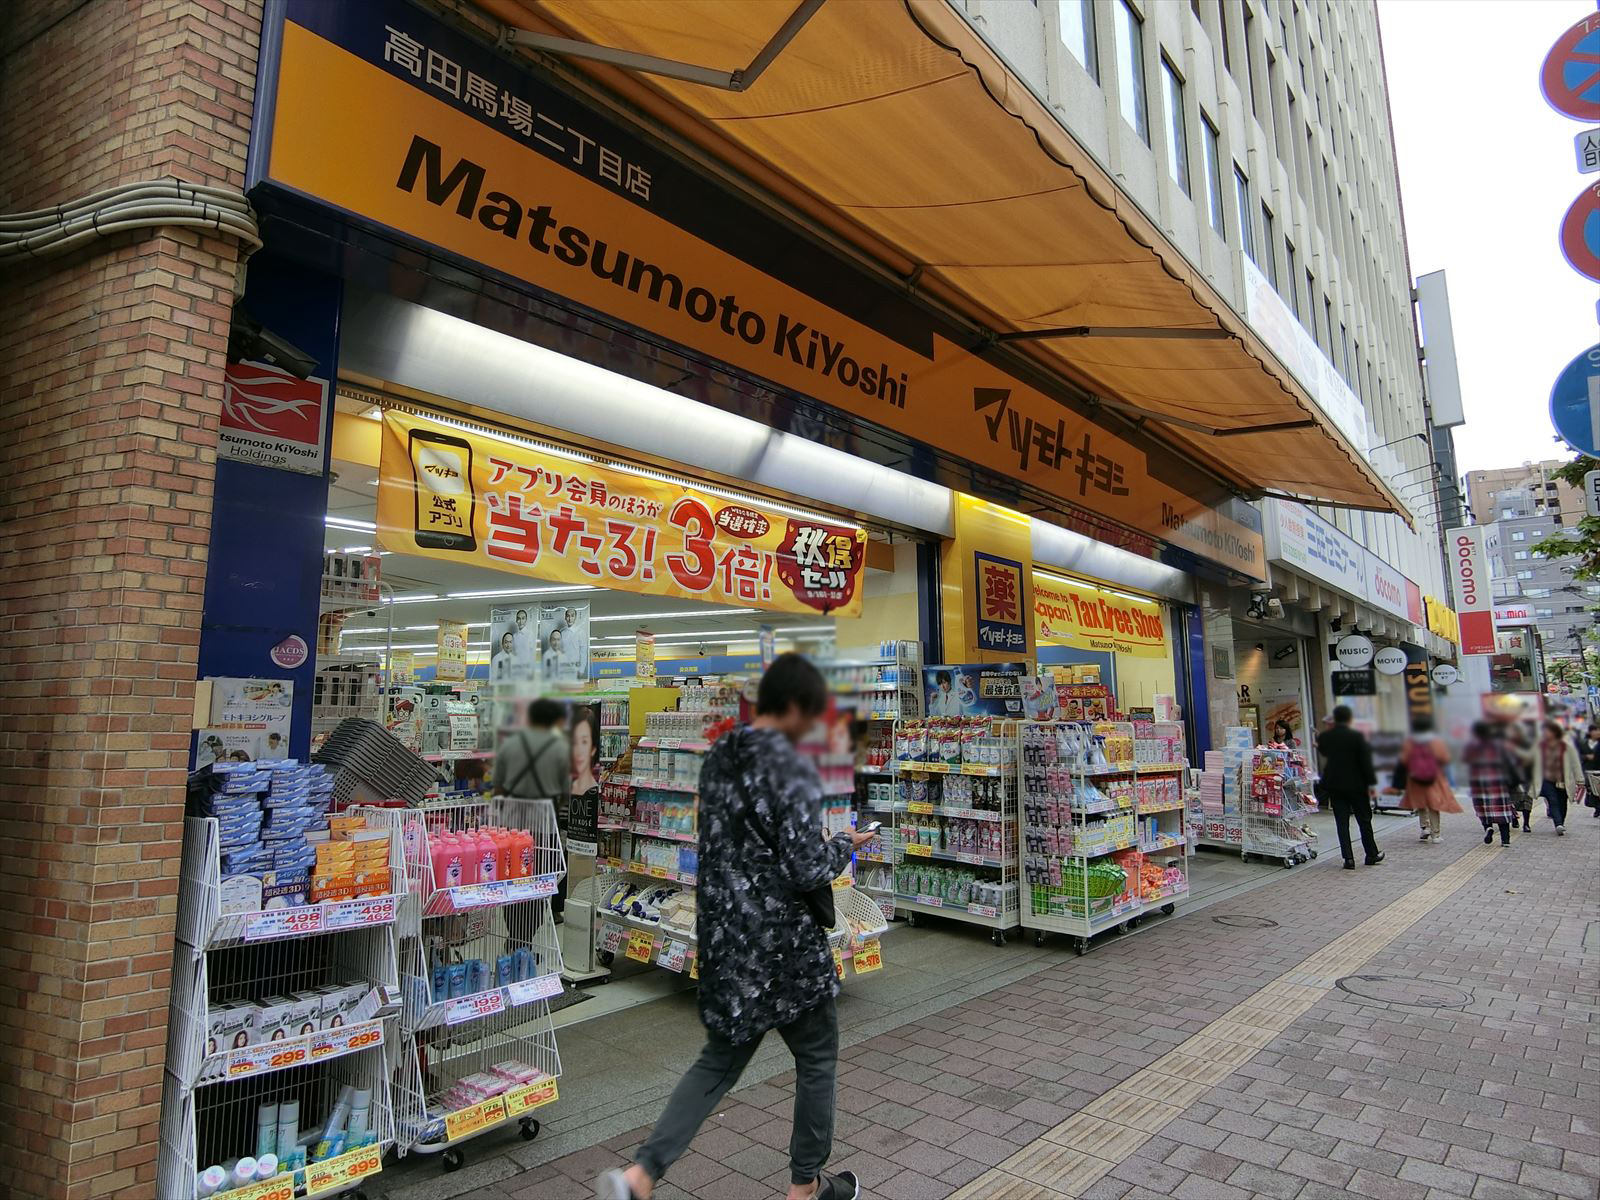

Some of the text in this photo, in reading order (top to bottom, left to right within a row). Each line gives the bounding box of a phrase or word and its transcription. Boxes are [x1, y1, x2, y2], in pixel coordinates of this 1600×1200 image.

[384, 25, 652, 201] 高田馬場二丁目店
[396, 134, 909, 410] Matsumoto KiYoshi
[274, 442, 319, 459] KiYoshi
[974, 387, 1129, 497] マツモトキヨシ
[230, 445, 287, 464] Holdings
[488, 457, 662, 519] アプリ会員のほうが
[432, 495, 457, 512] 公式
[429, 510, 464, 528] アプリ
[717, 510, 768, 535] 当選確率
[791, 526, 853, 569] 秋得
[801, 567, 848, 589] セール
[1456, 535, 1477, 605] docomo
[984, 565, 1017, 621] 薬
[1033, 584, 1060, 601] elcome
[1069, 592, 1102, 629] Tax
[980, 625, 1025, 648] マツモトキヨシ
[275, 645, 305, 655] JACDS
[1339, 647, 1369, 656] MUSIC
[1376, 657, 1403, 665] MOVIE
[570, 798, 593, 817] ONE
[285, 912, 320, 924] 498
[361, 903, 393, 915] 498
[366, 912, 392, 921] 462
[290, 921, 319, 931] 462
[473, 995, 500, 1008] 199
[348, 1030, 381, 1049] 298
[271, 1049, 306, 1067] 298
[347, 1157, 379, 1177] 399
